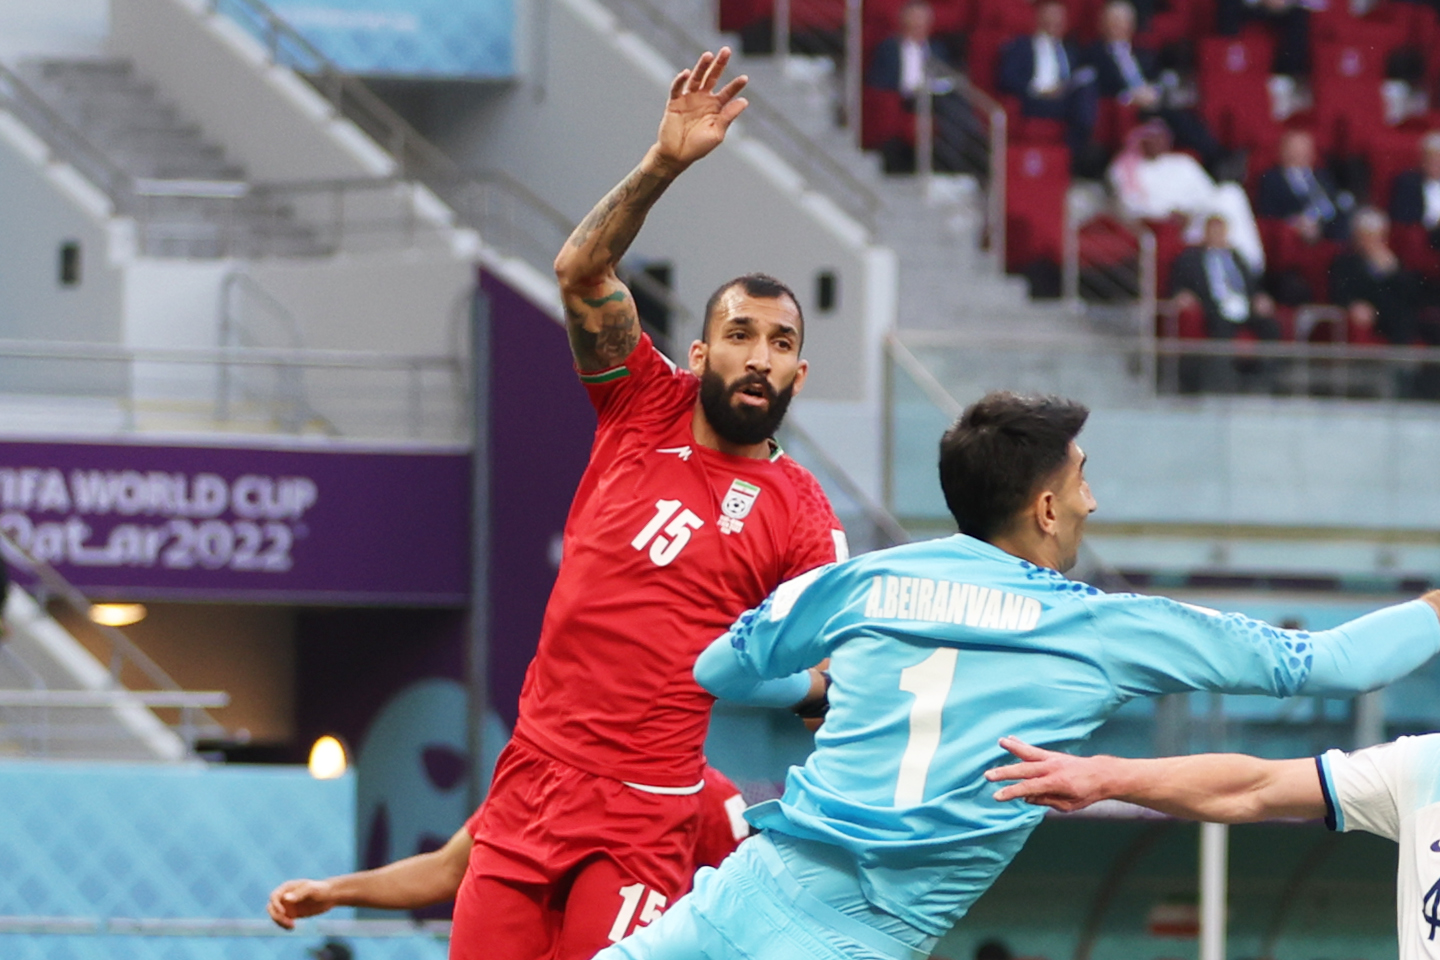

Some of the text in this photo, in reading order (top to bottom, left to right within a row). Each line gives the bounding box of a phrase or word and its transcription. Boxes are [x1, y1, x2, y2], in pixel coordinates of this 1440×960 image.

[70, 468, 230, 518] WORLD
[231, 473, 319, 520] CUP
[630, 498, 705, 567] 15
[864, 574, 1042, 632] A.BEIRANVAND
[898, 646, 958, 808] 1
[607, 882, 668, 943] 15
